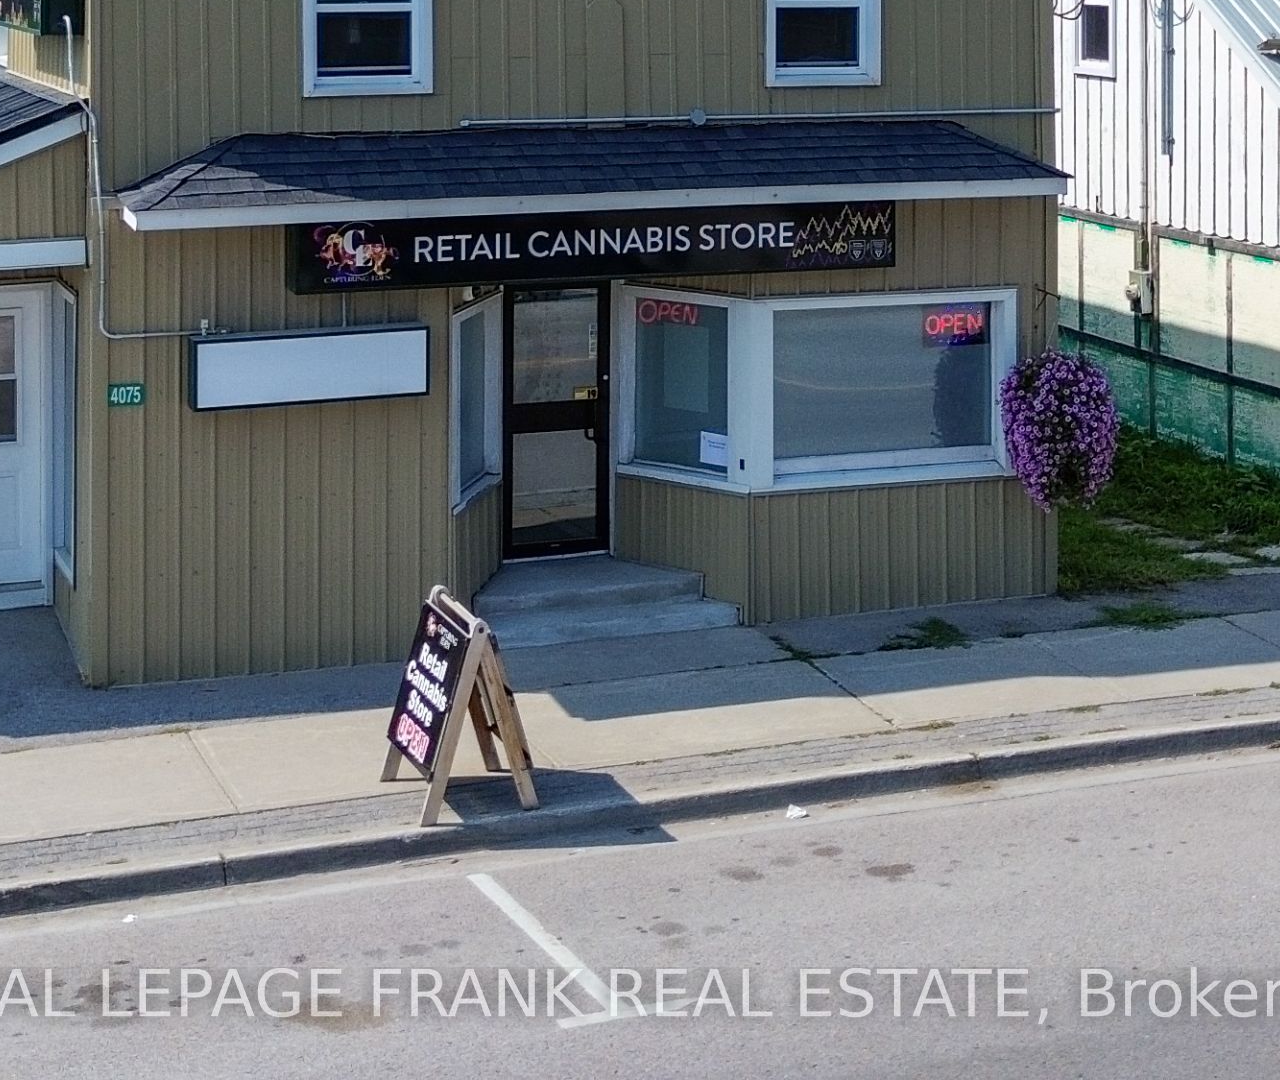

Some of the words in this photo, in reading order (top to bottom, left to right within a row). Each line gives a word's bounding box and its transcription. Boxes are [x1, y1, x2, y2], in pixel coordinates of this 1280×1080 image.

[413, 233, 520, 263] RETAIL
[527, 224, 692, 259] CANNABIS
[698, 221, 796, 252] STORE
[638, 300, 699, 325] OPEN
[925, 314, 983, 335] OPEN
[110, 386, 141, 404] 4075
[419, 642, 448, 683] Retail
[406, 660, 447, 713] Cannabis
[407, 689, 433, 727] Store
